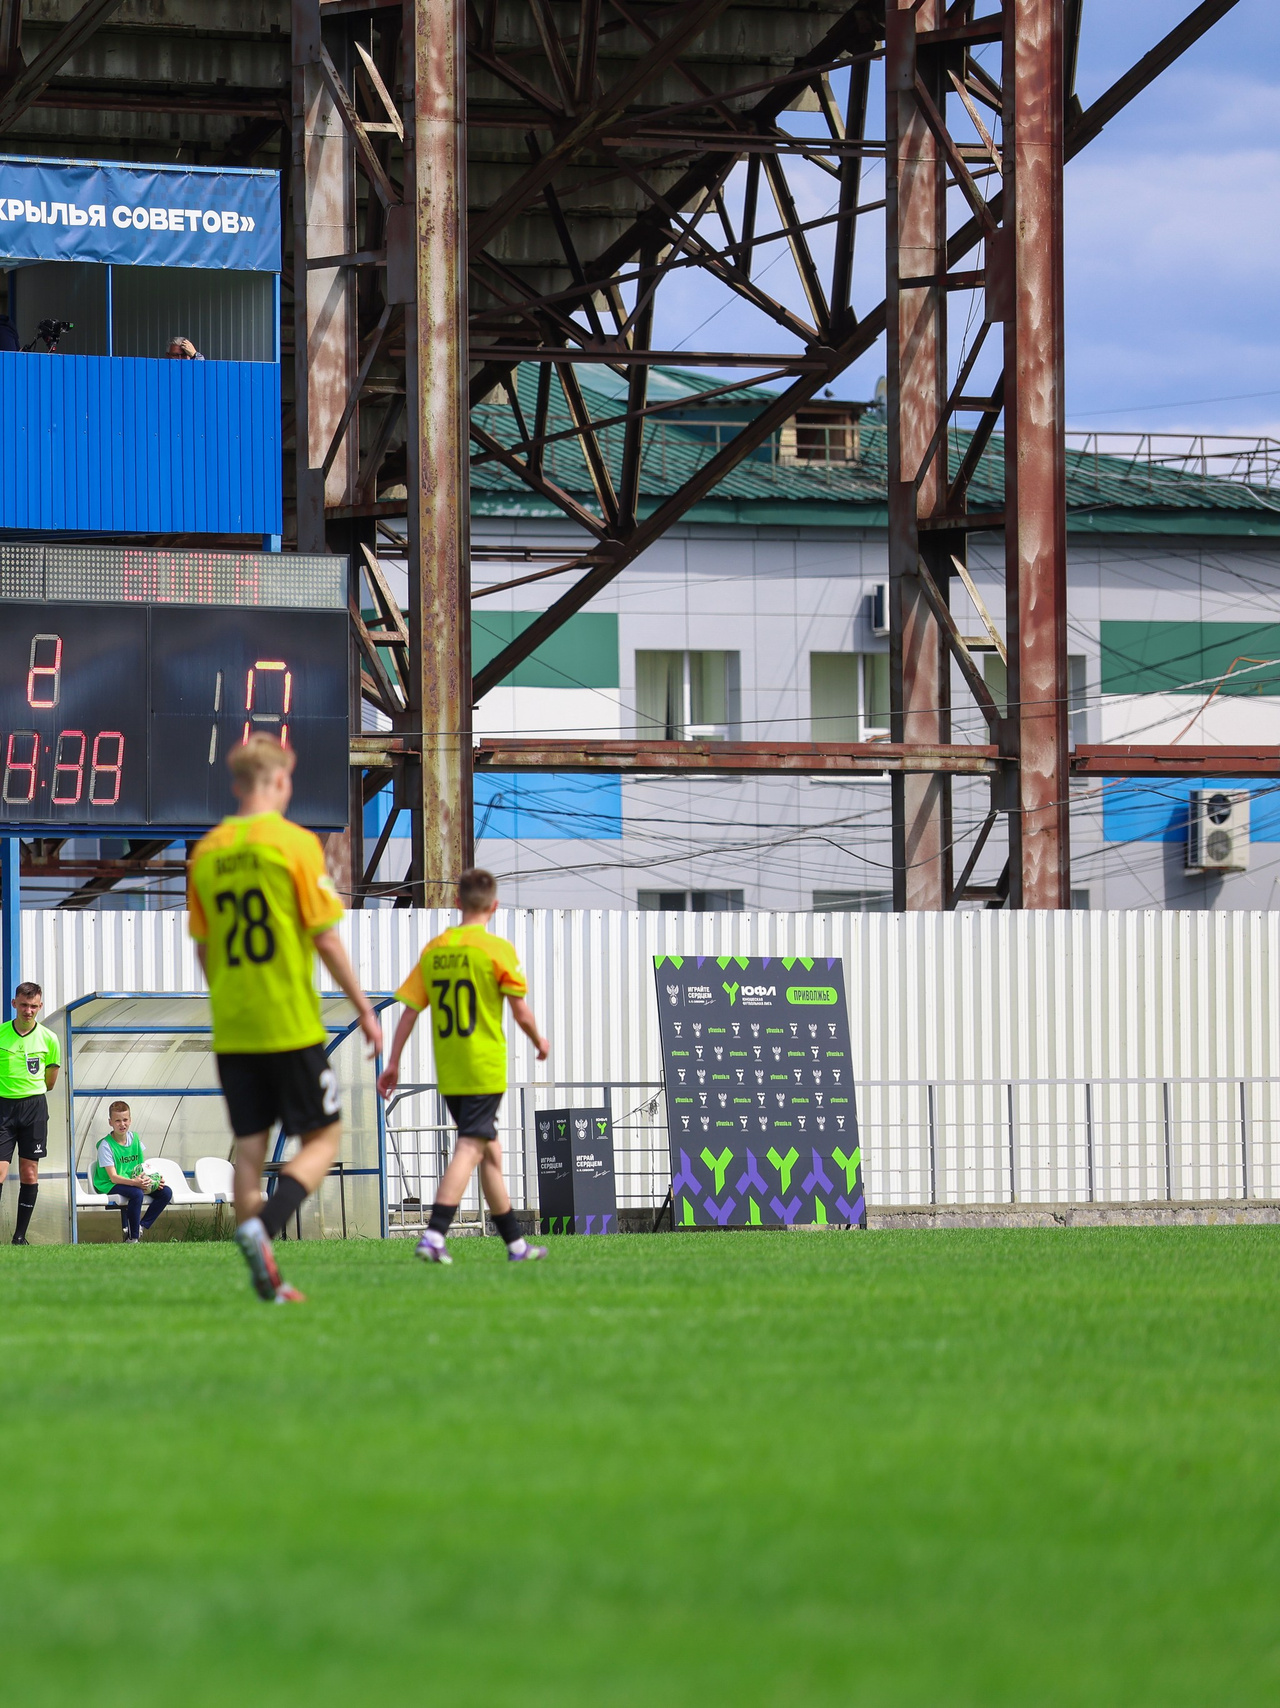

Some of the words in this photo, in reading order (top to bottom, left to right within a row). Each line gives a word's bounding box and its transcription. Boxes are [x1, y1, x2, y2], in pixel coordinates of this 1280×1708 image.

[112, 205, 256, 234] СОВЕТОВ»
[123, 548, 259, 605] ВОЛГА
[215, 887, 276, 967] 28
[740, 985, 777, 997] ЮФЛ
[793, 989, 831, 1001] ПРИВОЛЖЬЕ
[431, 977, 477, 1039] 30
[576, 1153, 594, 1161] ИГРАЙ
[576, 1160, 603, 1168] СЕРДЦЕМ
